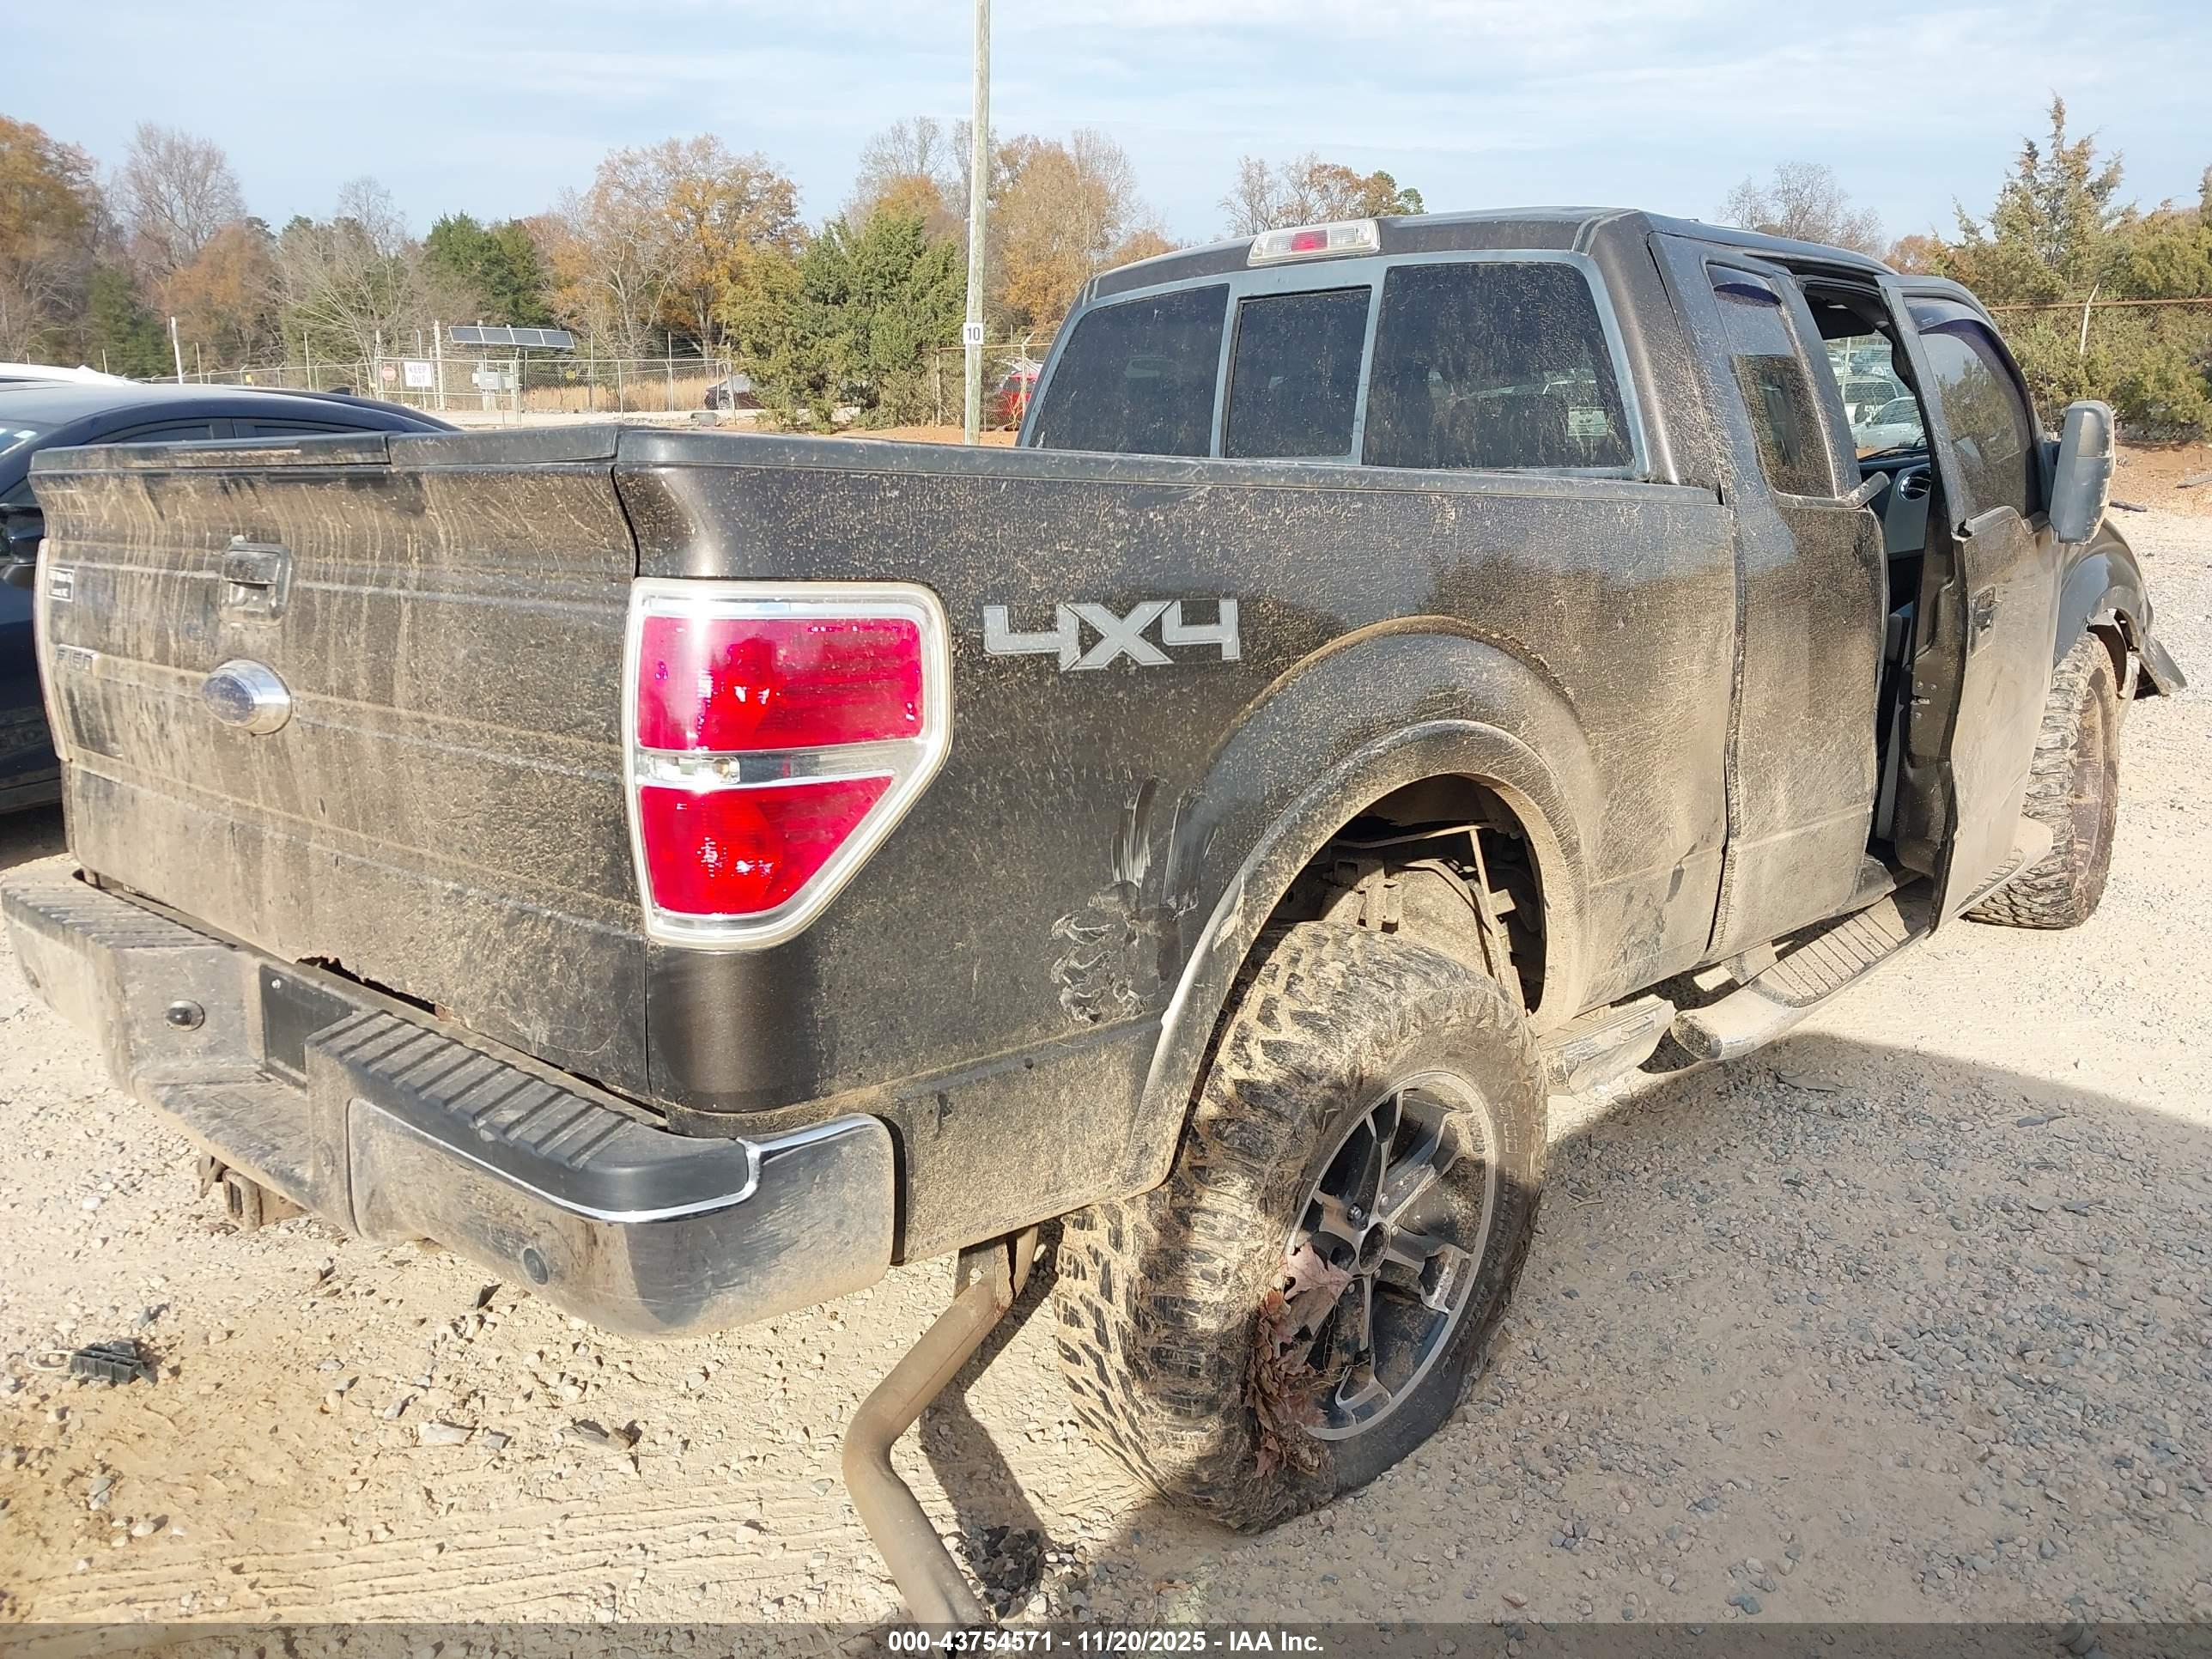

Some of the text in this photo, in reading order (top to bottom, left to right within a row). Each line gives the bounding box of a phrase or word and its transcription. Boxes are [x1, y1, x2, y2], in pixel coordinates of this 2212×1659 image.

[967, 327, 980, 340] 10
[409, 365, 427, 374] KEEP
[412, 374, 426, 384] OUT
